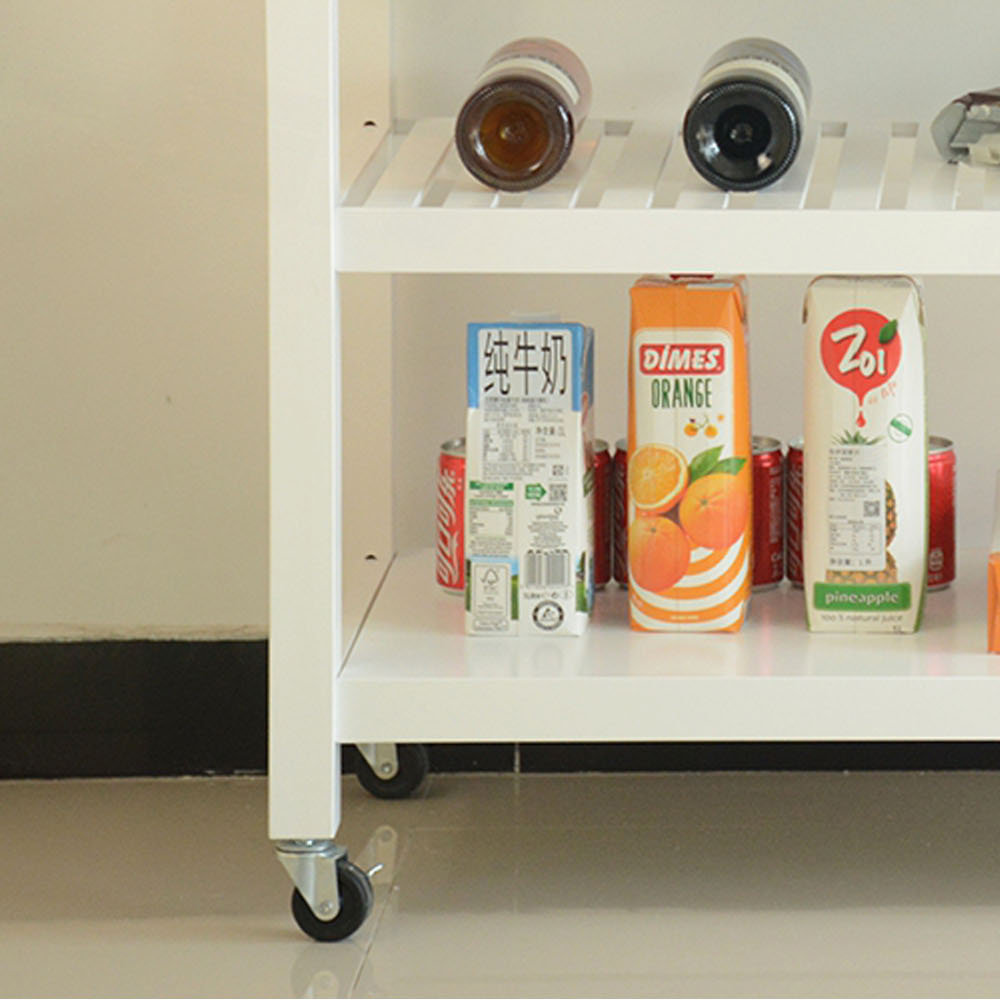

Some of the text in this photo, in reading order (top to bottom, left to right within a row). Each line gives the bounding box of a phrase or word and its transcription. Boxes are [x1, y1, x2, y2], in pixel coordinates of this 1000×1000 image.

[484, 330, 568, 396] 纯牛奶
[651, 378, 712, 408] ORANGE
[825, 591, 899, 606] pineapple
[881, 613, 903, 624] juice
